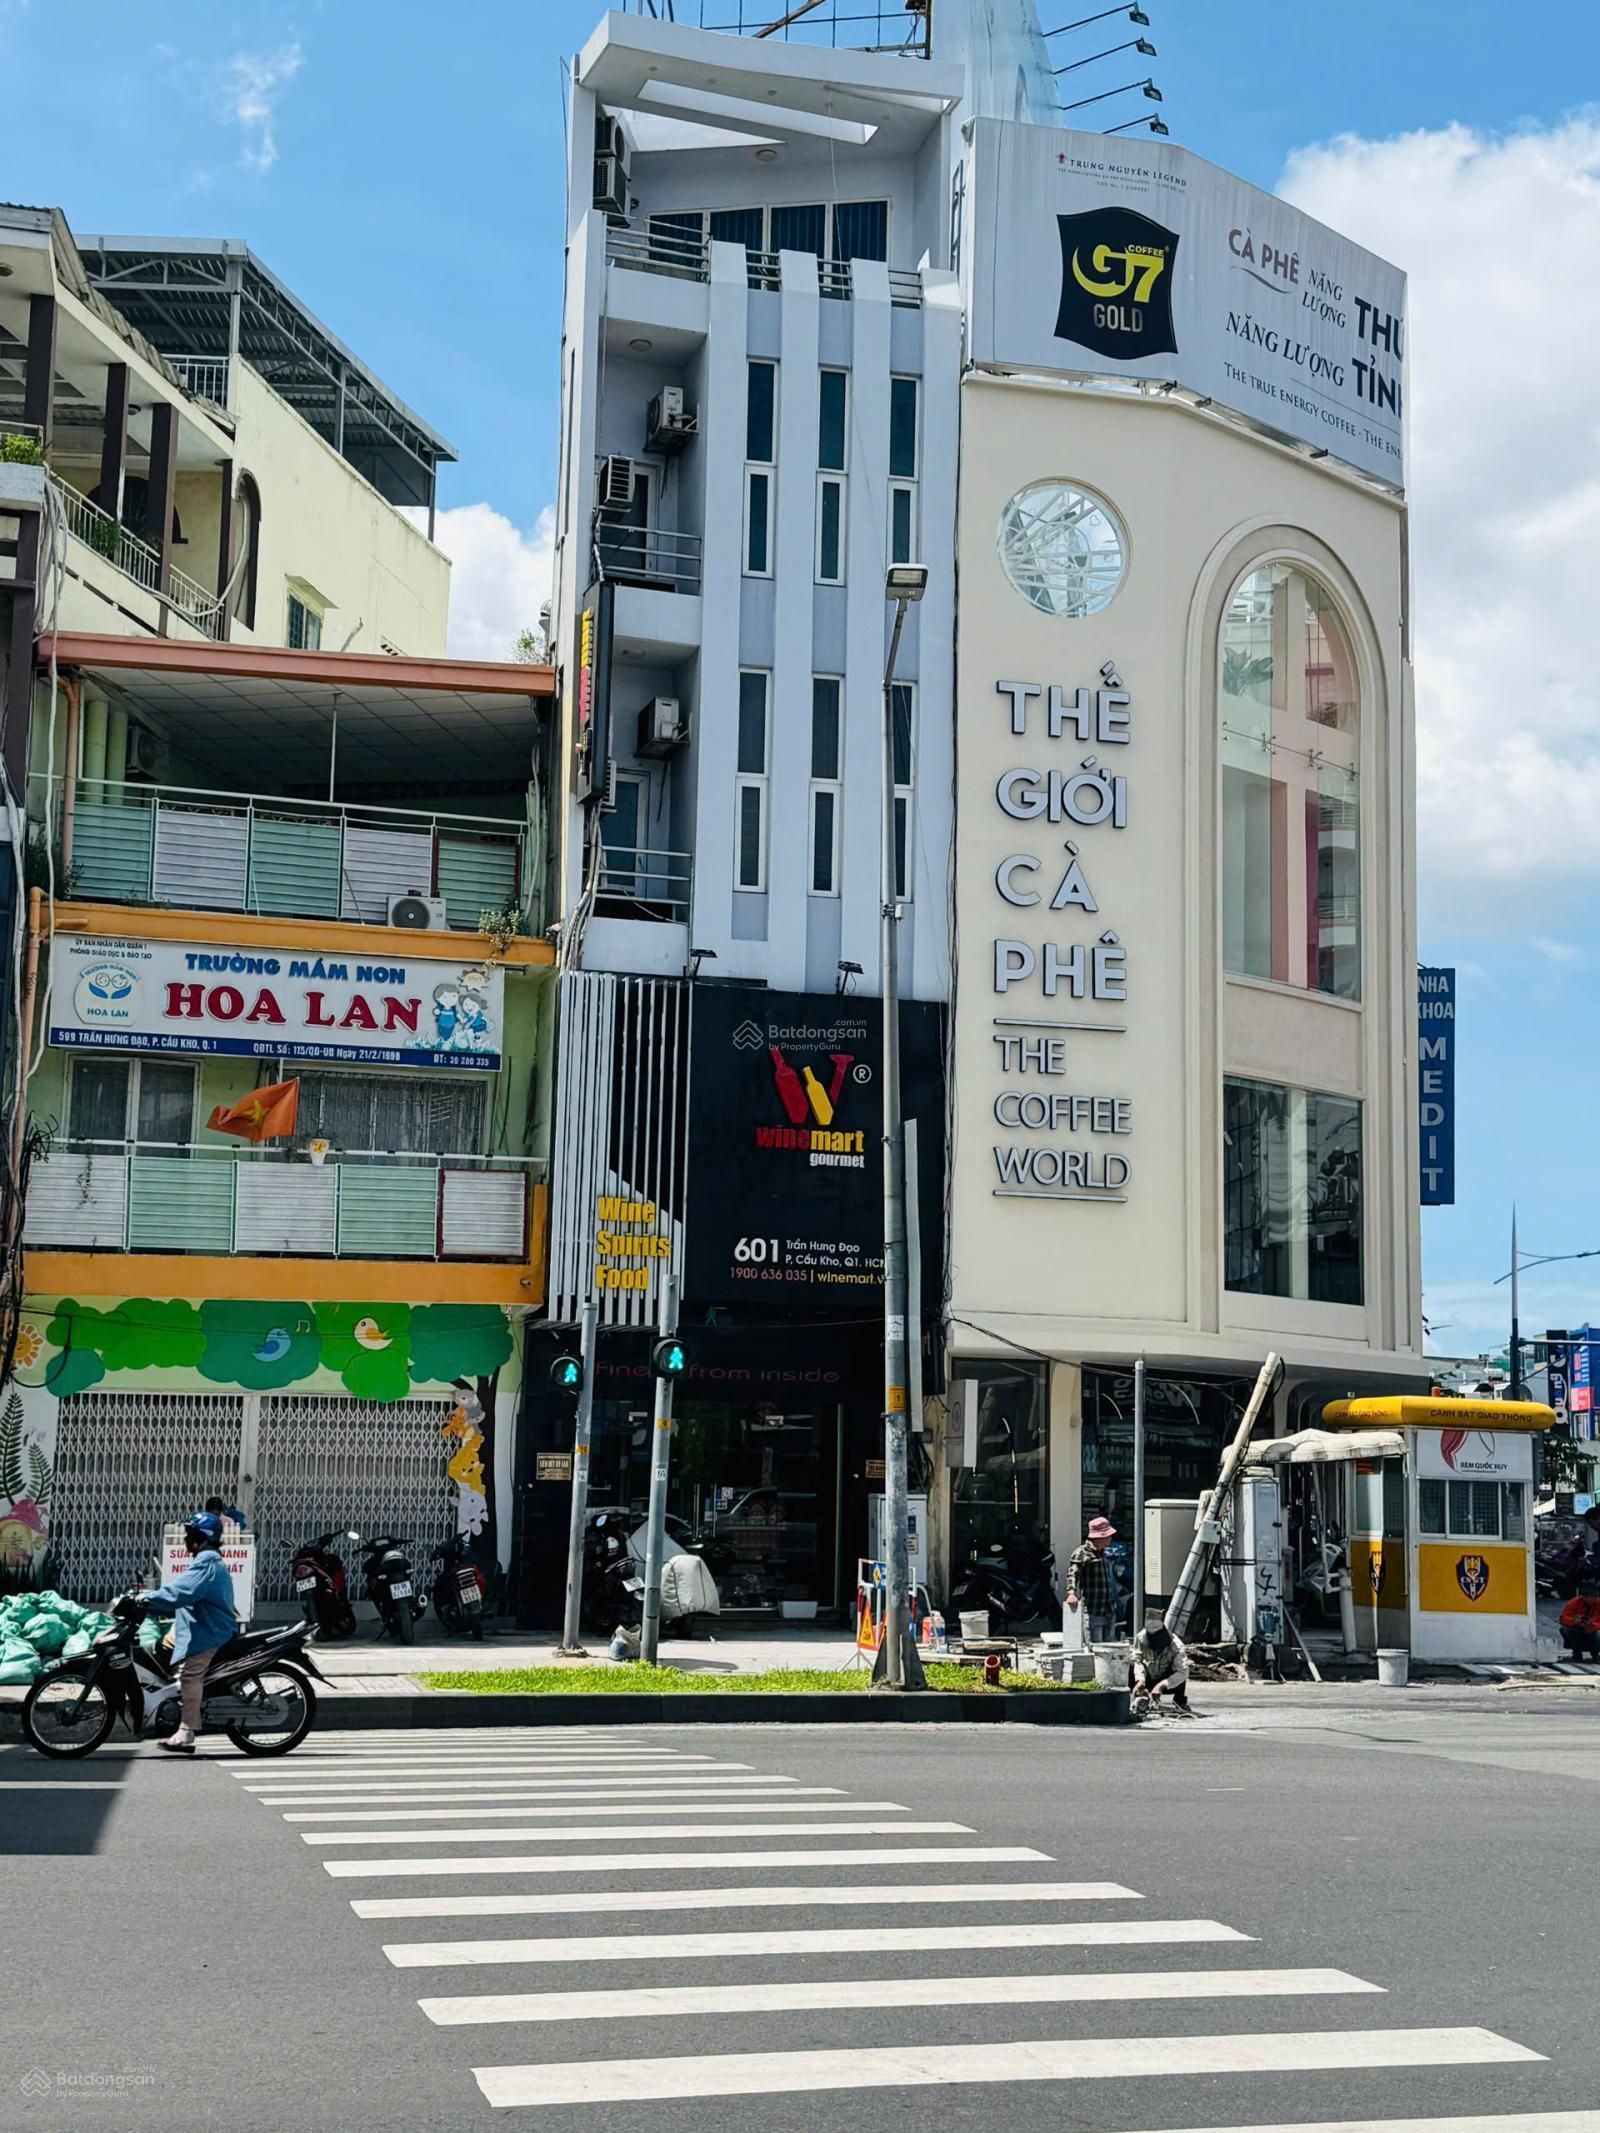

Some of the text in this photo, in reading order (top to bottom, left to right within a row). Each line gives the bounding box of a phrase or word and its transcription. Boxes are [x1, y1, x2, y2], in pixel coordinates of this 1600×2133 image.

[1070, 159, 1104, 171] TRUNG
[1153, 172, 1187, 187] LEGEND
[1128, 245, 1165, 258] COFFEE
[1229, 227, 1300, 285] CÀ PHÊ
[1072, 244, 1164, 303] G7
[1308, 269, 1343, 301] NĂNG
[1093, 304, 1143, 333] GOLD
[1225, 311, 1345, 387] NĂNG LƯỢNG
[1224, 361, 1247, 384] THE
[1249, 375, 1277, 398] TRUE
[1280, 389, 1320, 418] ENERGY
[1321, 409, 1356, 437] COFFEE
[1363, 428, 1383, 450] THE
[997, 660, 1131, 745] THẾ
[996, 755, 1127, 829] GIỚI
[995, 840, 1099, 912] CÀ
[185, 952, 281, 976] TRƯỜNG
[356, 966, 405, 984] NON
[993, 930, 1127, 1001] PHÊ
[87, 1008, 129, 1017] HOA LAN
[163, 982, 422, 1033] HOA LAN
[993, 1034, 1067, 1076] THE
[993, 1091, 1133, 1136] COFFEE
[1419, 1036, 1447, 1192] MEDIT
[756, 1125, 864, 1153] winemart
[809, 1152, 865, 1168] gourmet
[993, 1146, 1133, 1190] WORLD
[597, 1196, 656, 1224] Wine
[597, 1230, 671, 1258] Spirits
[734, 1238, 779, 1263] 601
[595, 1264, 649, 1290] Food
[730, 1267, 758, 1280] 1900
[761, 1269, 783, 1280] 636
[785, 1270, 807, 1281] 035
[820, 1256, 842, 1268] Kho,
[688, 1364, 750, 1380] from
[760, 1367, 840, 1383] inside
[1502, 1412, 1533, 1423] THÔNG
